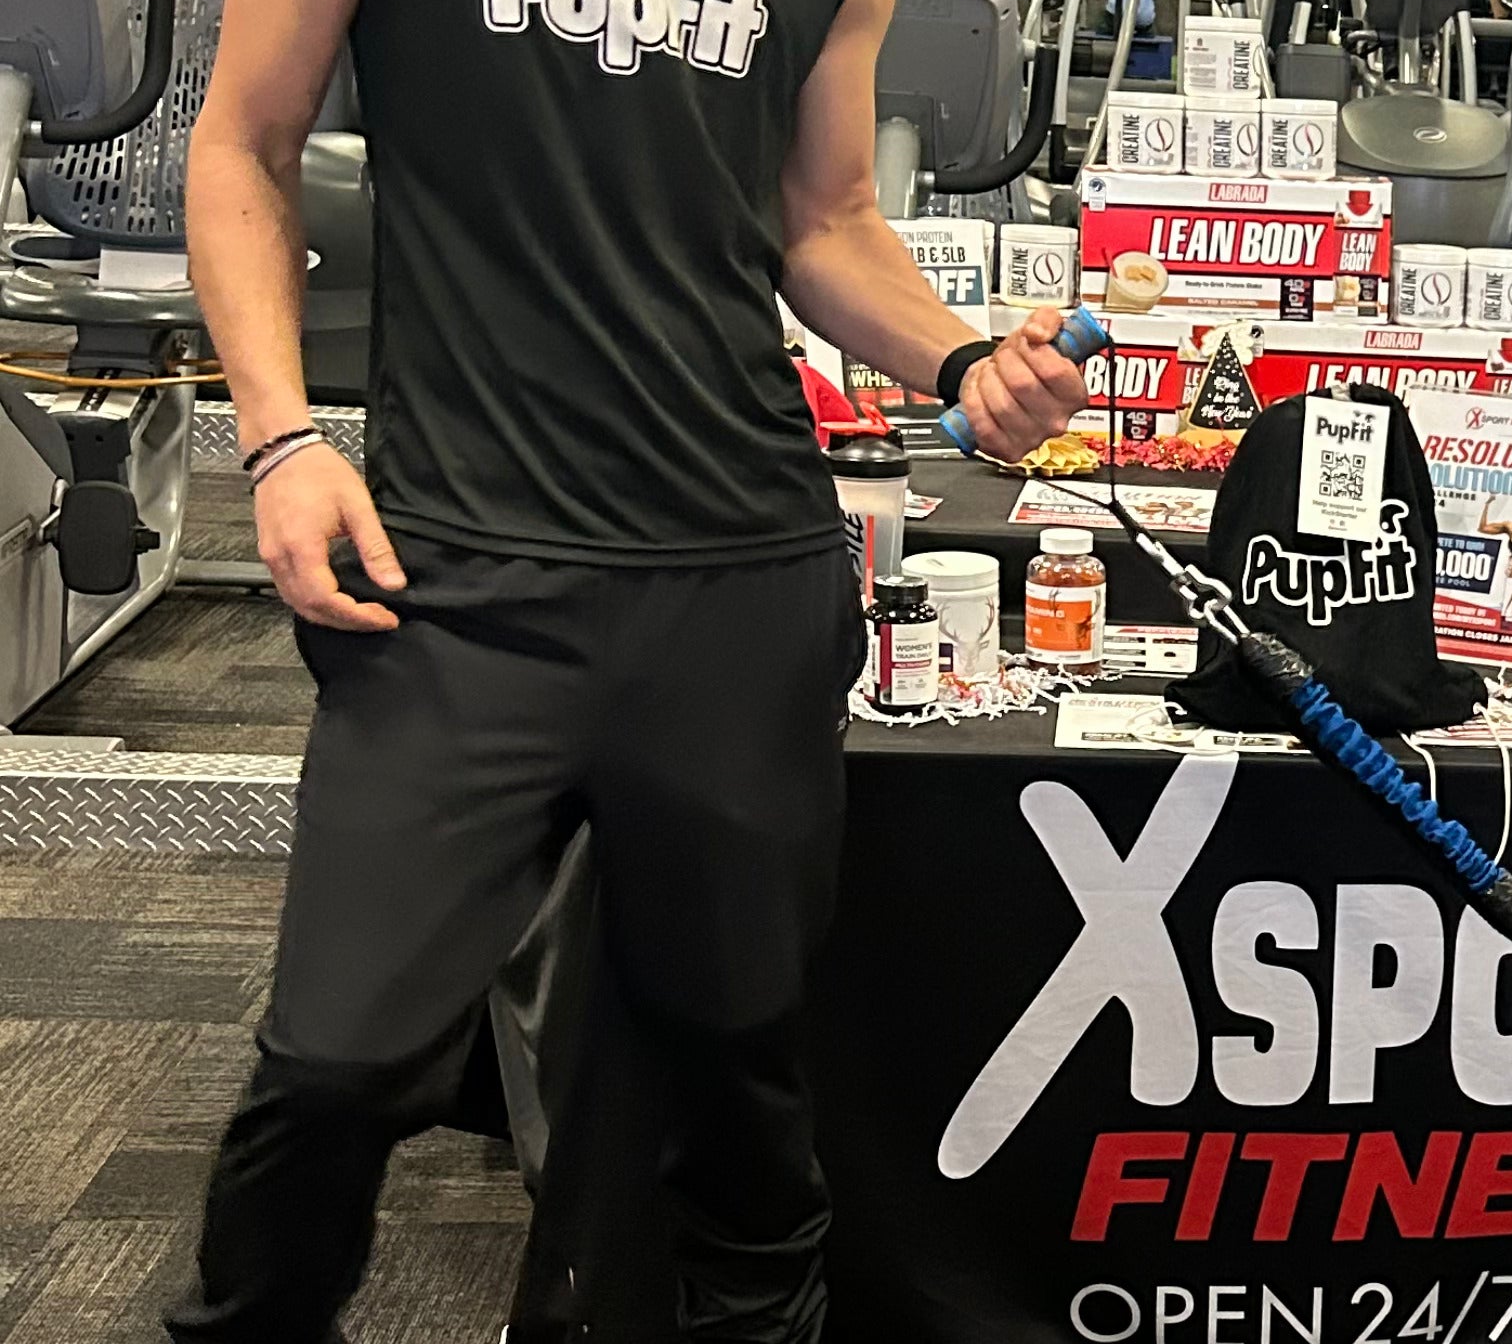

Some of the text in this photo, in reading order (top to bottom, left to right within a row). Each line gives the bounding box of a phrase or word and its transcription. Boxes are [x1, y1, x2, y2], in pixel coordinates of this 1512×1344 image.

[1233, 40, 1250, 90] CREATINE
[1121, 113, 1140, 164] CREATINE
[1213, 118, 1232, 168] CREATINE
[1271, 118, 1289, 168] CREATINE
[1210, 184, 1267, 203] LABRADA
[917, 231, 953, 244] PROTEIN
[942, 246, 966, 263] 5LB
[1150, 217, 1327, 266] LEAN BODY
[1341, 232, 1378, 253] LEAN
[1010, 247, 1029, 297] CREATINE
[1339, 252, 1374, 273] BODY
[1400, 268, 1418, 316] CREATINE
[1484, 271, 1504, 321] CREATINE
[1365, 331, 1423, 350] LABRADA
[850, 370, 901, 387] WHE
[1084, 354, 1169, 399] BODY
[1315, 416, 1374, 444] PupFit
[1243, 535, 1416, 625] PupFit
